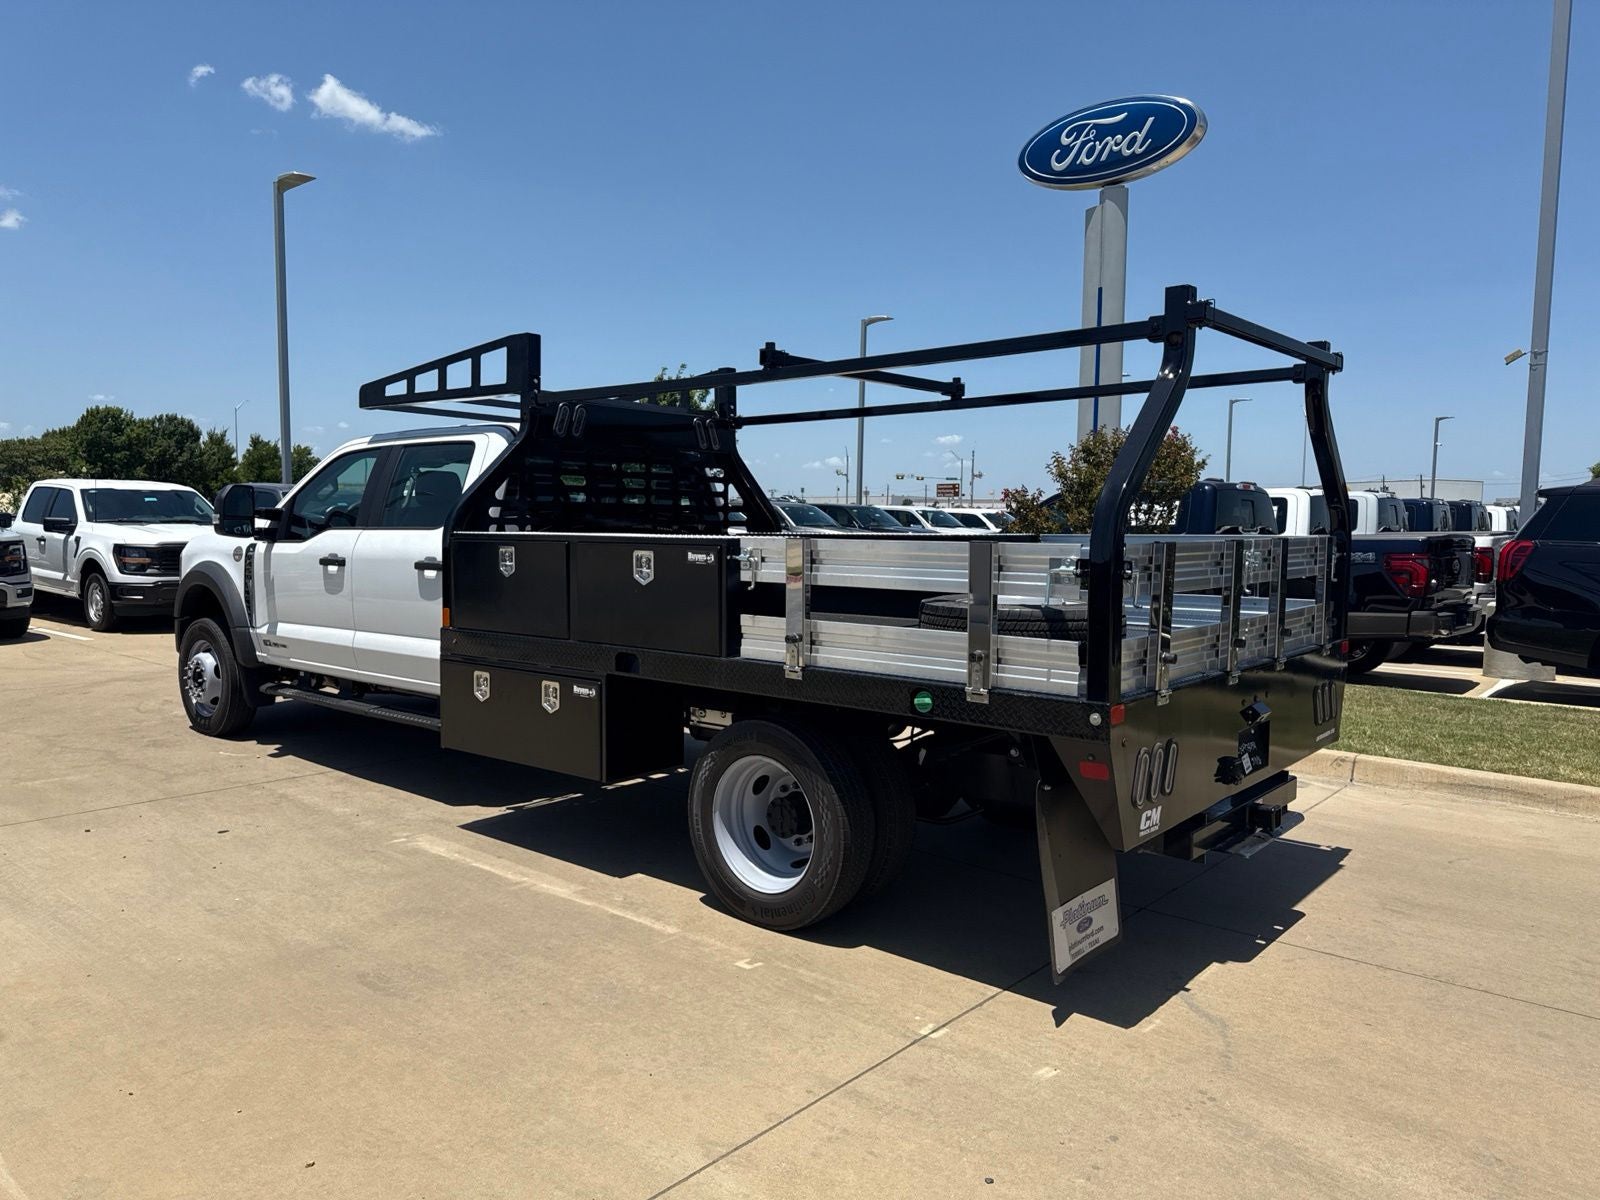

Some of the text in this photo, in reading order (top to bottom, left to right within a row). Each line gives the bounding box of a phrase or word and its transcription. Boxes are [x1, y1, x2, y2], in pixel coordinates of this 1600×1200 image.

[1051, 112, 1155, 171] Ford
[1140, 805, 1162, 830] CM
[760, 887, 817, 920] Continental
[1060, 894, 1110, 930] Platinum
